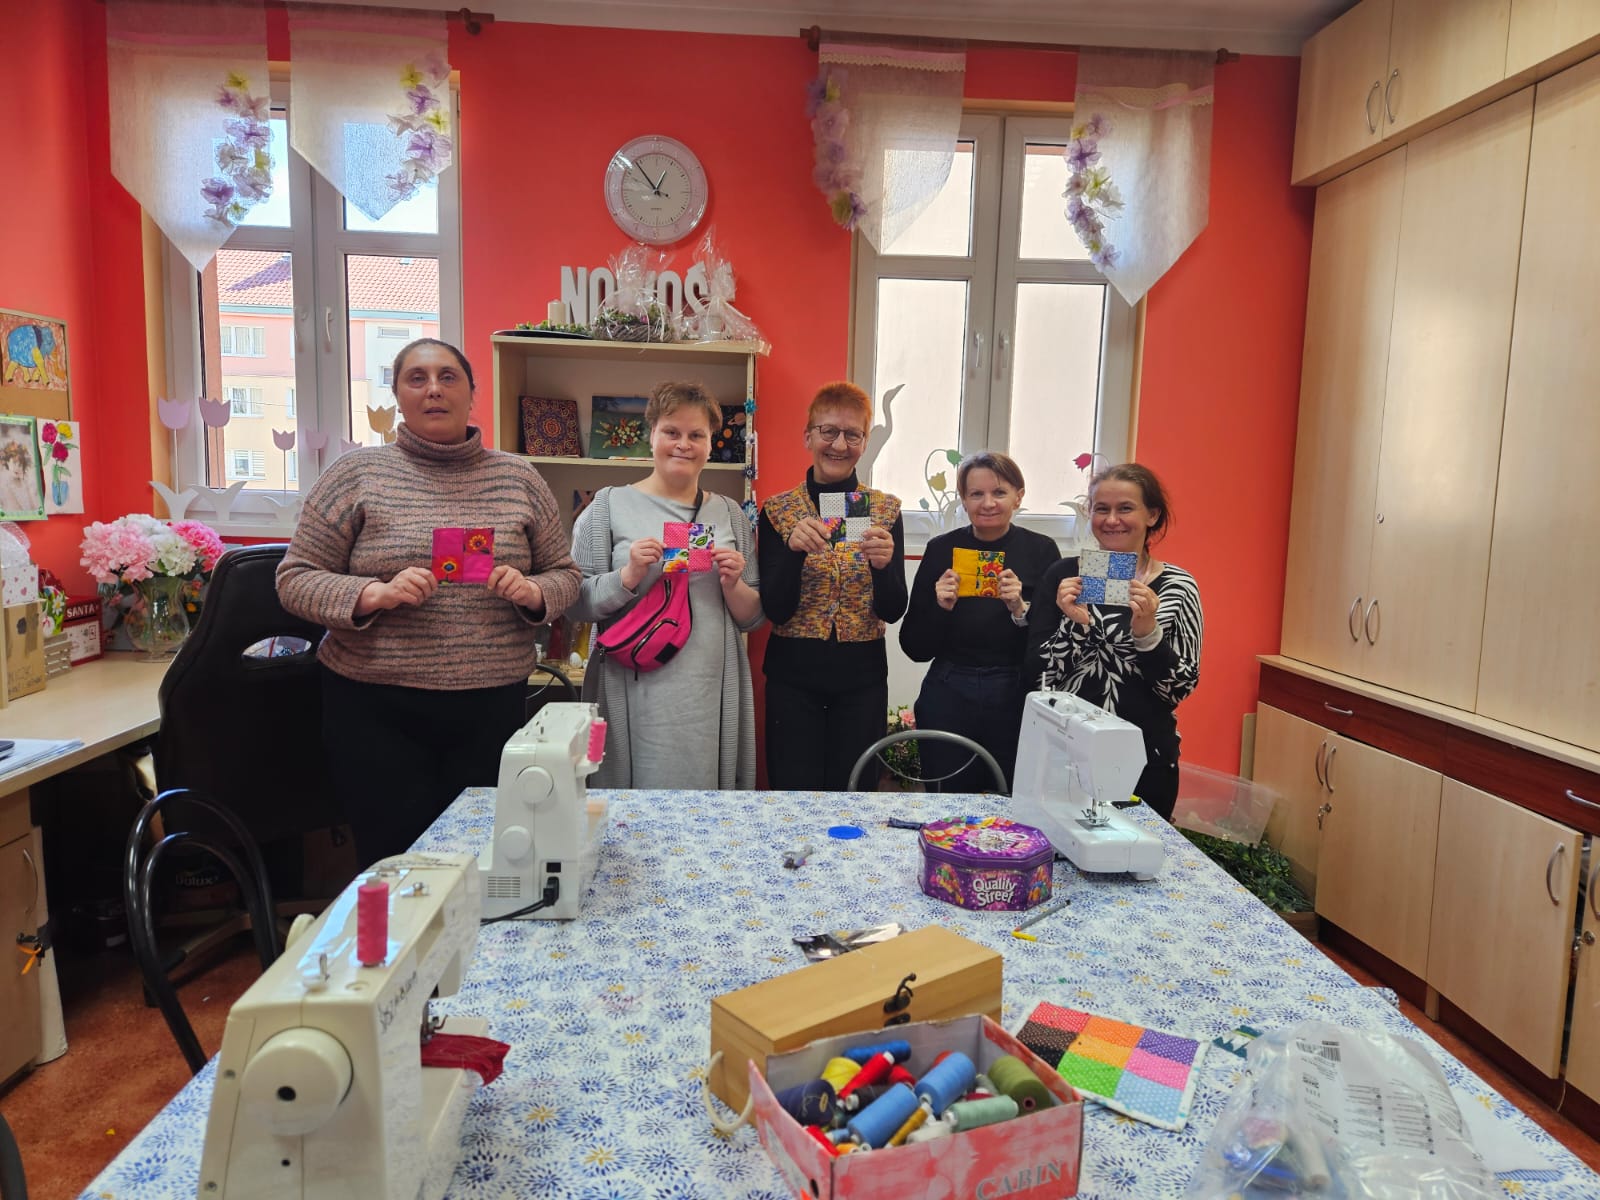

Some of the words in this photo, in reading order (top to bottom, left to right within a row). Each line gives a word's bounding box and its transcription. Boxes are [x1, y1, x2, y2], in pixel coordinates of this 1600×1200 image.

[972, 877, 1018, 893] Quality
[976, 890, 1014, 907] Street
[976, 1160, 1062, 1200] CABIN
